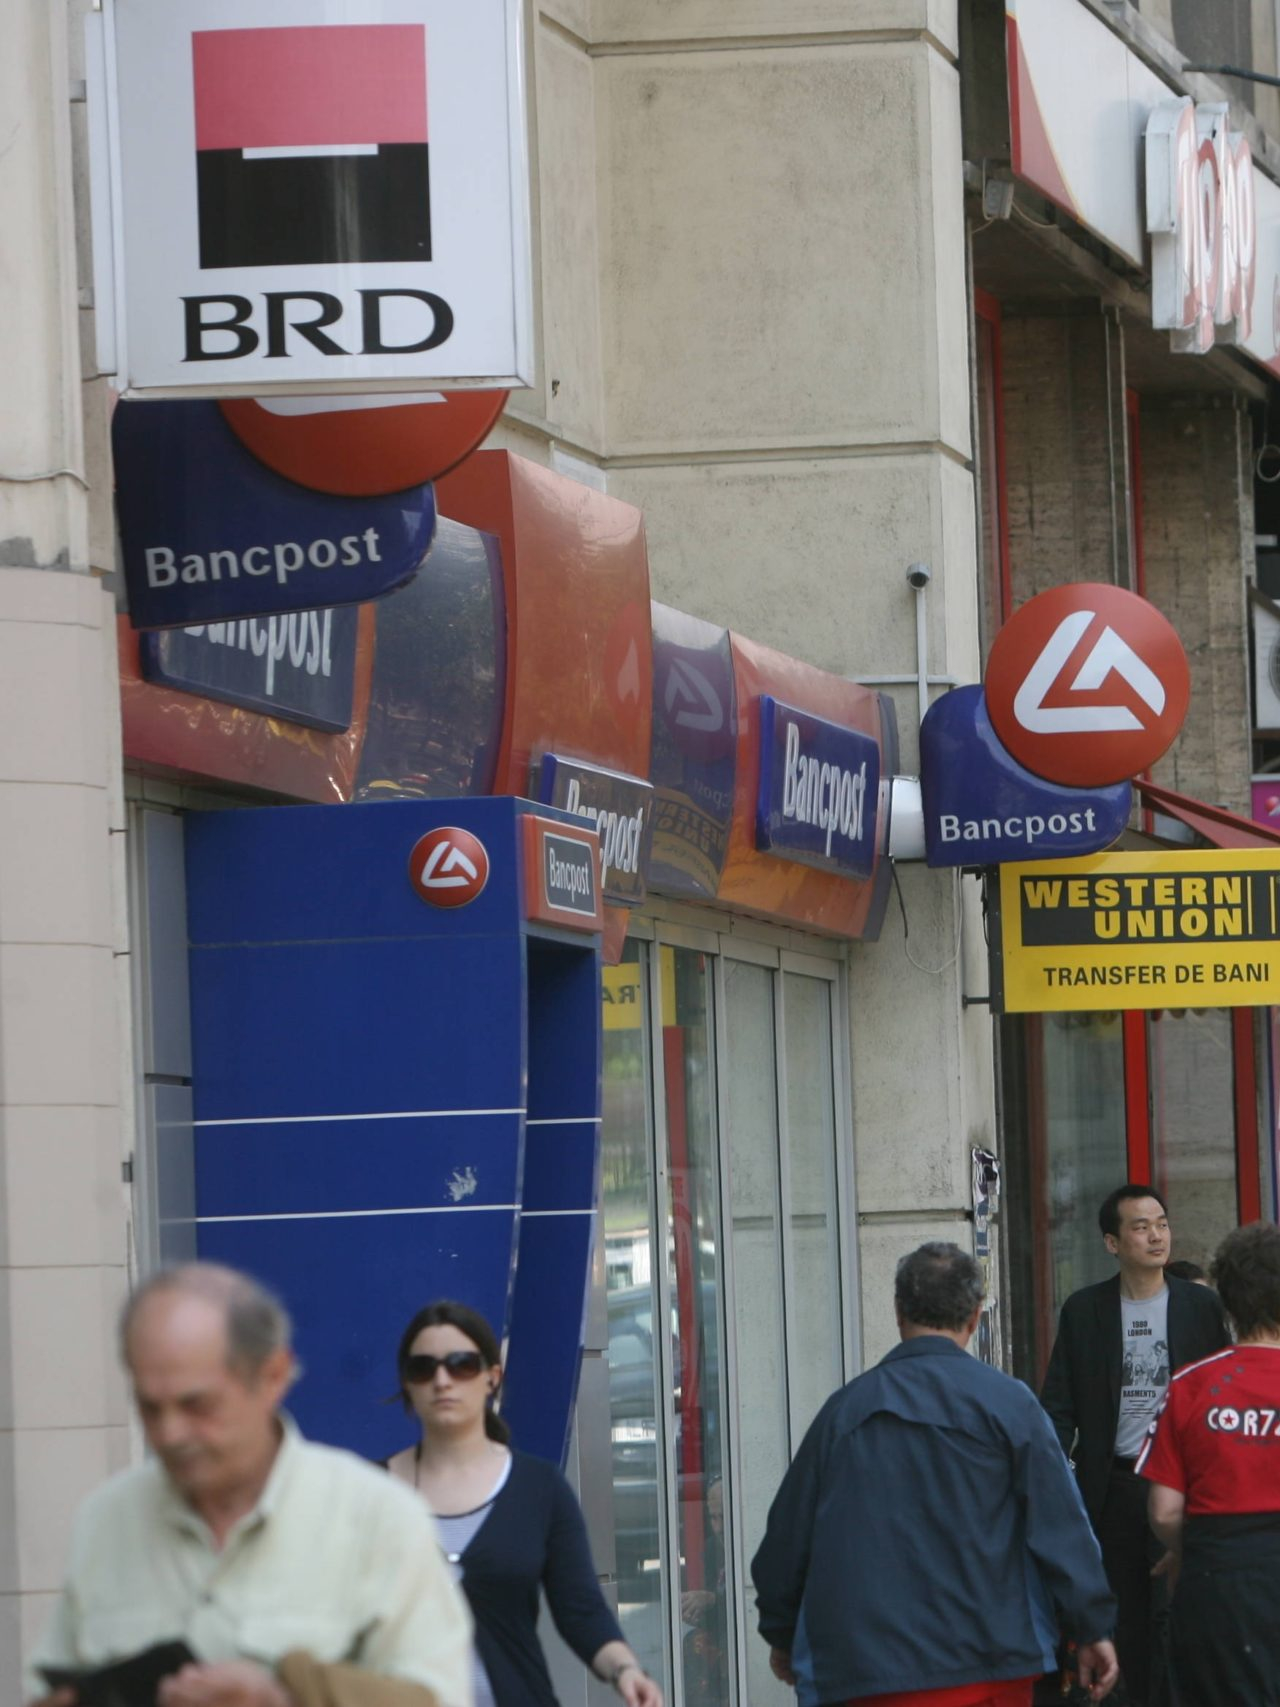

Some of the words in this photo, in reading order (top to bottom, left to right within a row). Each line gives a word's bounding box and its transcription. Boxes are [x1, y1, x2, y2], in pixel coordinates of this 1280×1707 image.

[178, 288, 454, 362] BRD
[144, 527, 381, 588] Bancpost
[783, 721, 867, 857] Bancpost
[939, 807, 1097, 844] Bancpost
[549, 847, 590, 910] Bancpost
[1023, 877, 1242, 910] WESTERN
[1094, 908, 1242, 939] UNION
[1043, 965, 1167, 987] TRANSFER
[1175, 964, 1205, 984] DE
[1213, 963, 1270, 984] BANI
[1127, 1328, 1152, 1337] LONDON
